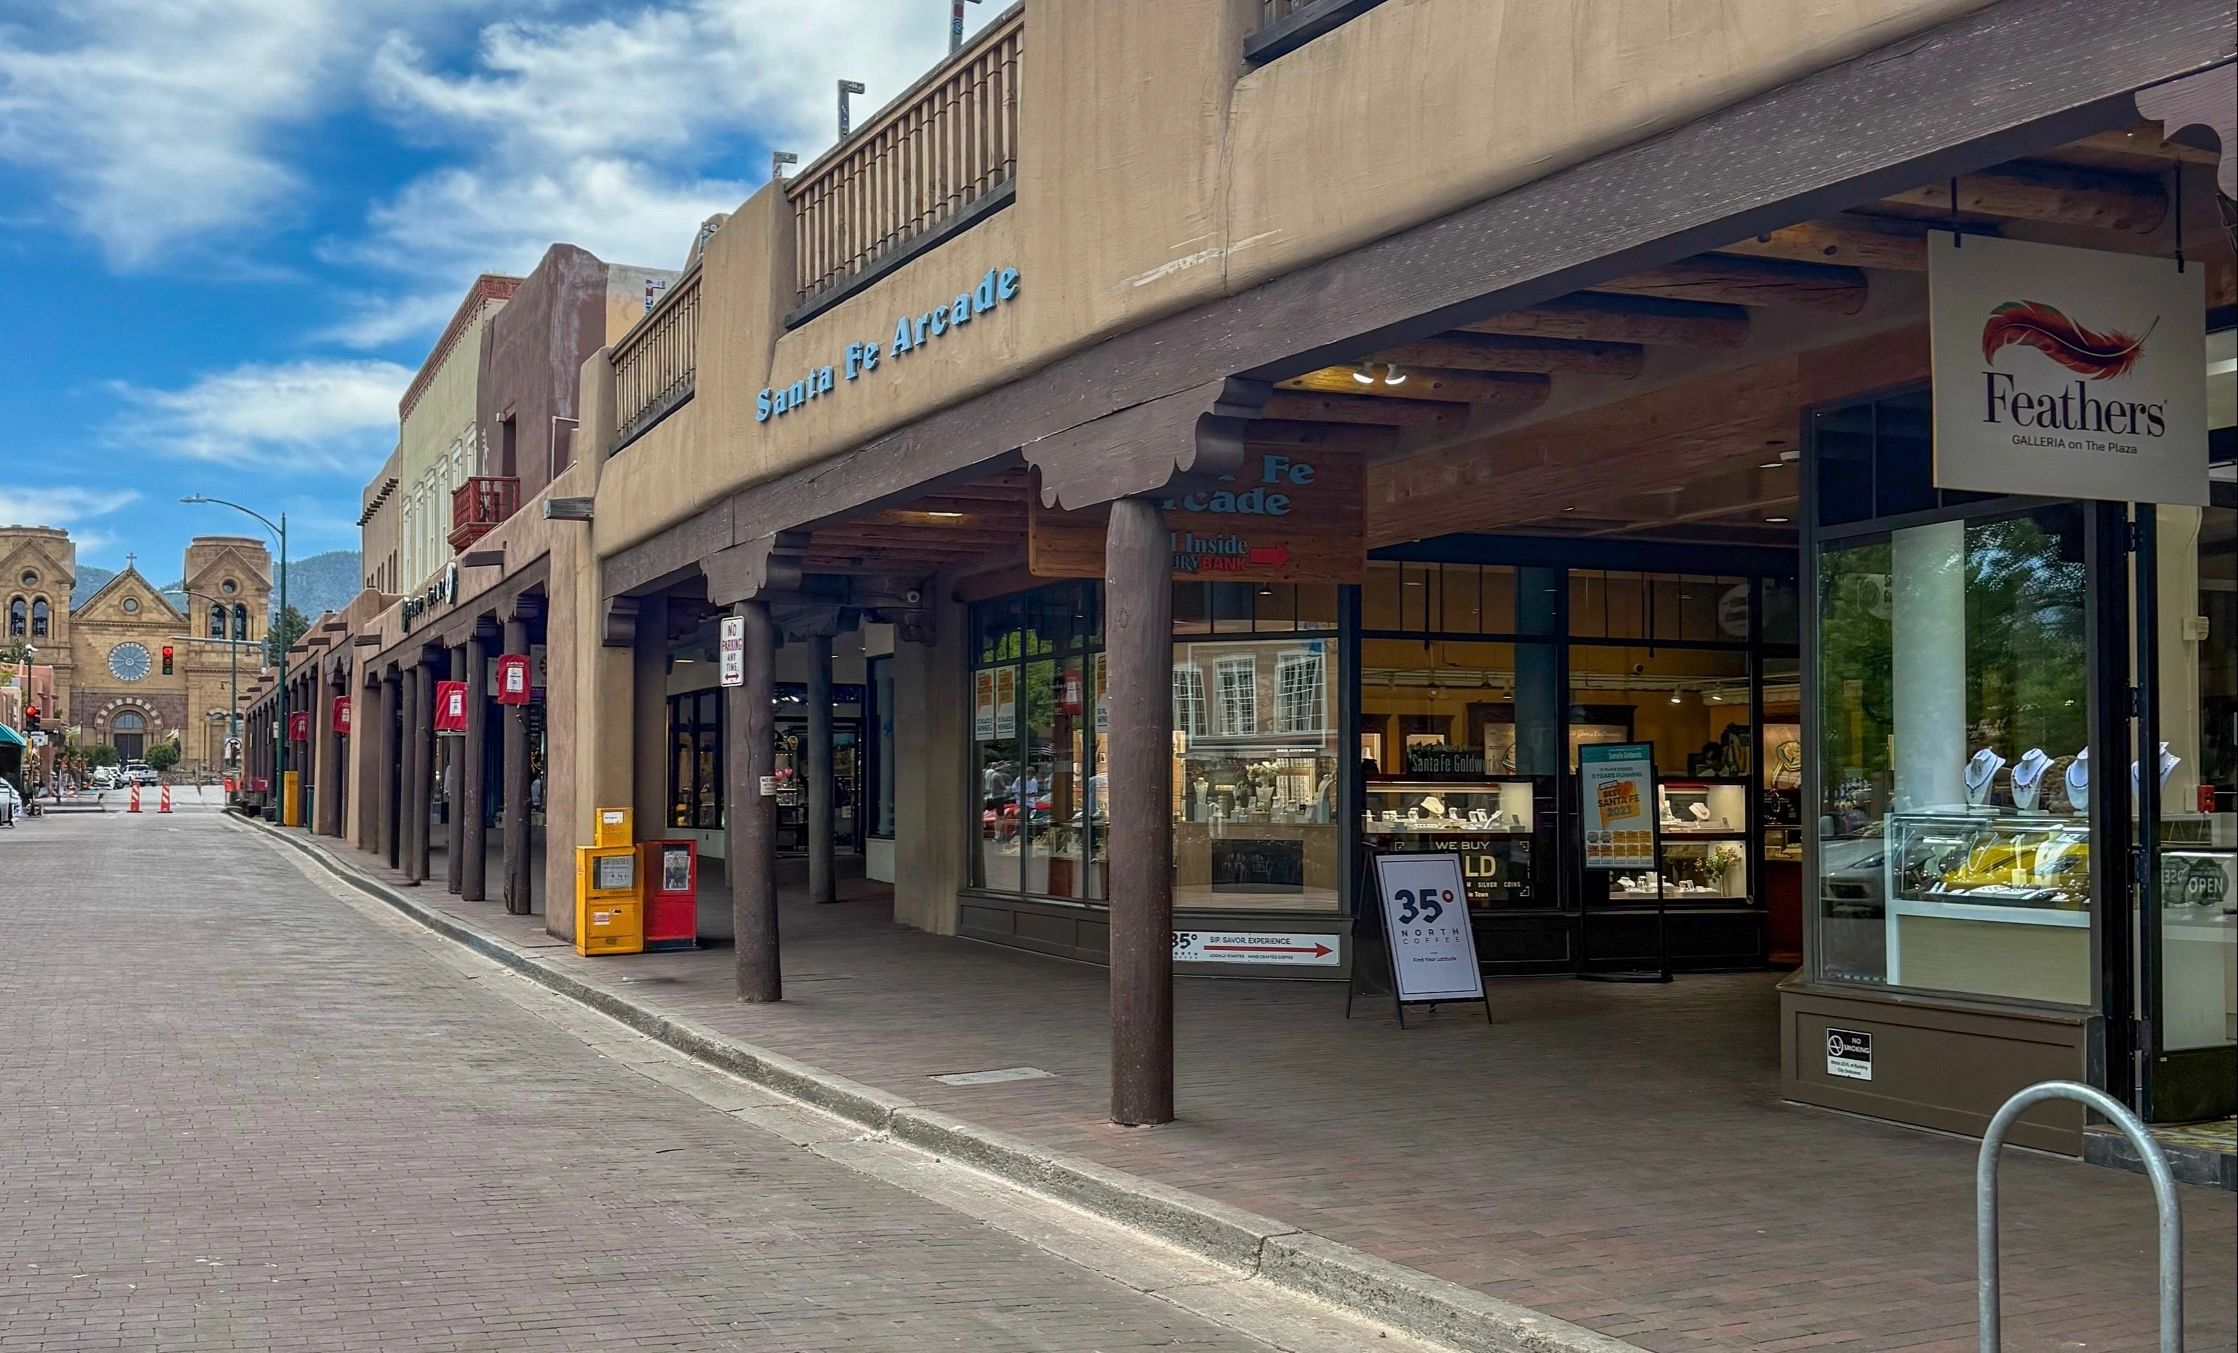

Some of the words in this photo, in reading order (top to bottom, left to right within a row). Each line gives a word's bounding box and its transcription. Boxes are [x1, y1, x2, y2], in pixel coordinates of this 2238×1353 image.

[755, 365, 834, 423] Santa
[844, 341, 880, 380] Fe
[891, 266, 1021, 357] Arcade
[1981, 371, 2166, 437] Feathers
[2012, 434, 2066, 449] GALLERIA
[2068, 440, 2083, 450] on
[2085, 440, 2106, 452] The
[2108, 442, 2138, 454] Plaza
[1263, 455, 1314, 485] Fe
[1184, 532, 1248, 554] Inside
[1202, 556, 1247, 571] BANK
[727, 623, 737, 637] NO
[721, 638, 742, 652] PARKING
[727, 653, 737, 662] ANY
[726, 662, 738, 672] TIME
[1436, 841, 1456, 850] WE
[1462, 841, 1490, 850] BUY
[1465, 855, 1497, 878] LD
[2188, 876, 2224, 893] OPEN
[1401, 928, 1460, 937] NORTH
[1402, 936, 1461, 945] COFFEE
[1844, 1044, 1870, 1053] SMOKING
